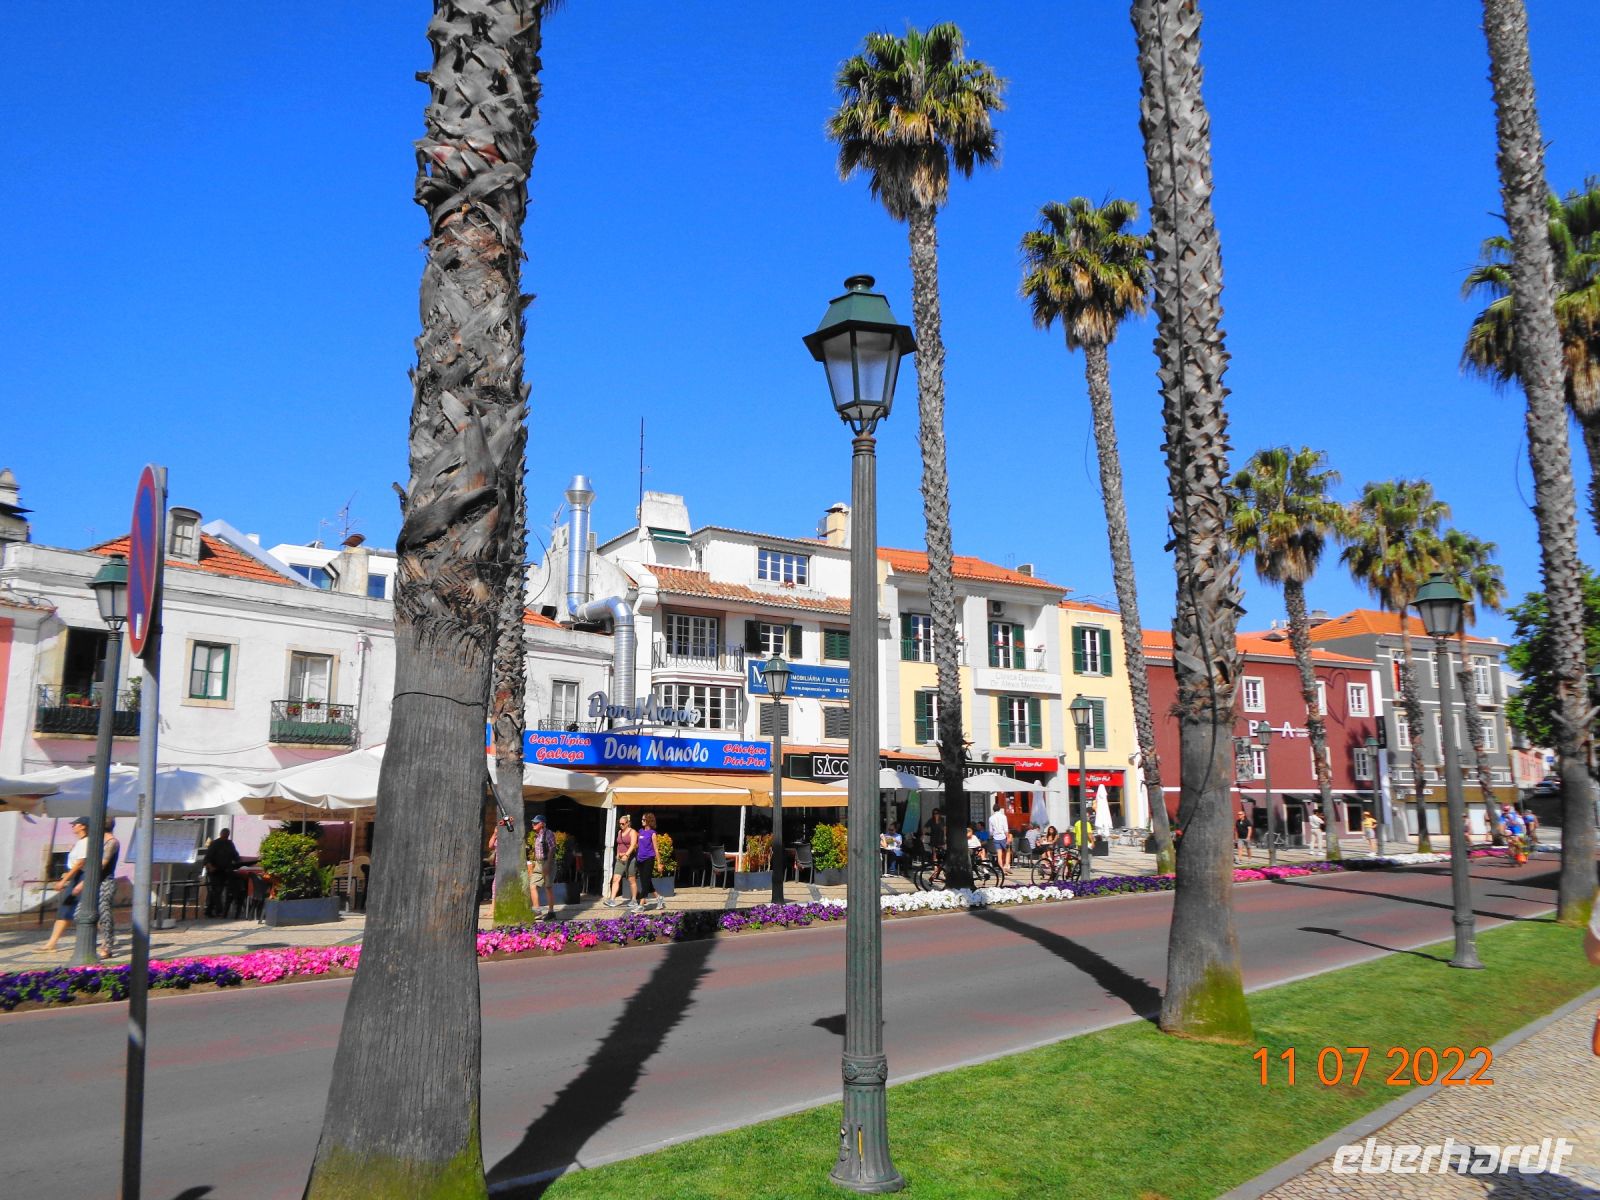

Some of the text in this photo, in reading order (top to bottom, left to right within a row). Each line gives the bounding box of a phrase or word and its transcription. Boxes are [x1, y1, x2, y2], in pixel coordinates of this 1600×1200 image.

[825, 676, 839, 684] REAL
[588, 691, 701, 724] Dom Manolo
[529, 733, 591, 747] Casa Típica
[536, 746, 585, 763] Galega
[604, 737, 709, 763] Dom Manolo
[723, 743, 767, 756] Chicken
[723, 756, 767, 767] Piri-Piri
[896, 764, 944, 777] PASTELA
